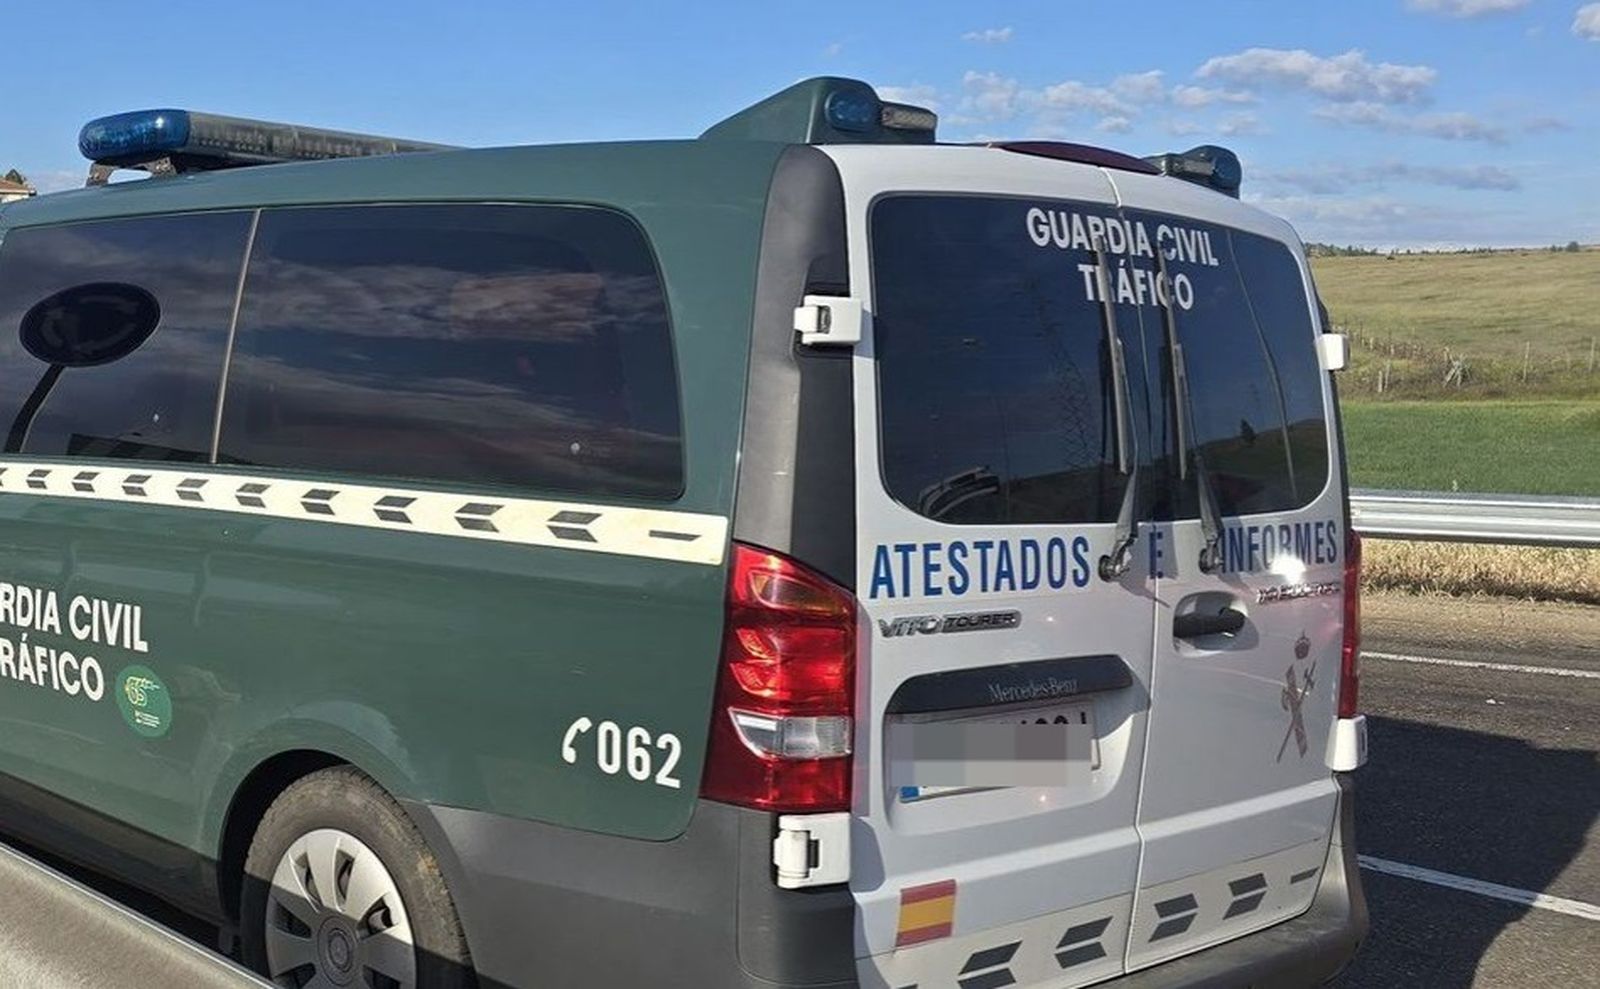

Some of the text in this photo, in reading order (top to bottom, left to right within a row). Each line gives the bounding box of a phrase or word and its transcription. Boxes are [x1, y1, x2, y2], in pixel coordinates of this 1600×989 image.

[1026, 207, 1220, 266] GUARDIA CIVIL
[869, 519, 1338, 599] ATESTADOS E INFORMES
[0, 582, 149, 652] RDIA CIVIL
[878, 610, 1019, 638] VITO TOURER
[0, 633, 105, 701] RÁFICO
[597, 721, 681, 789] 062
